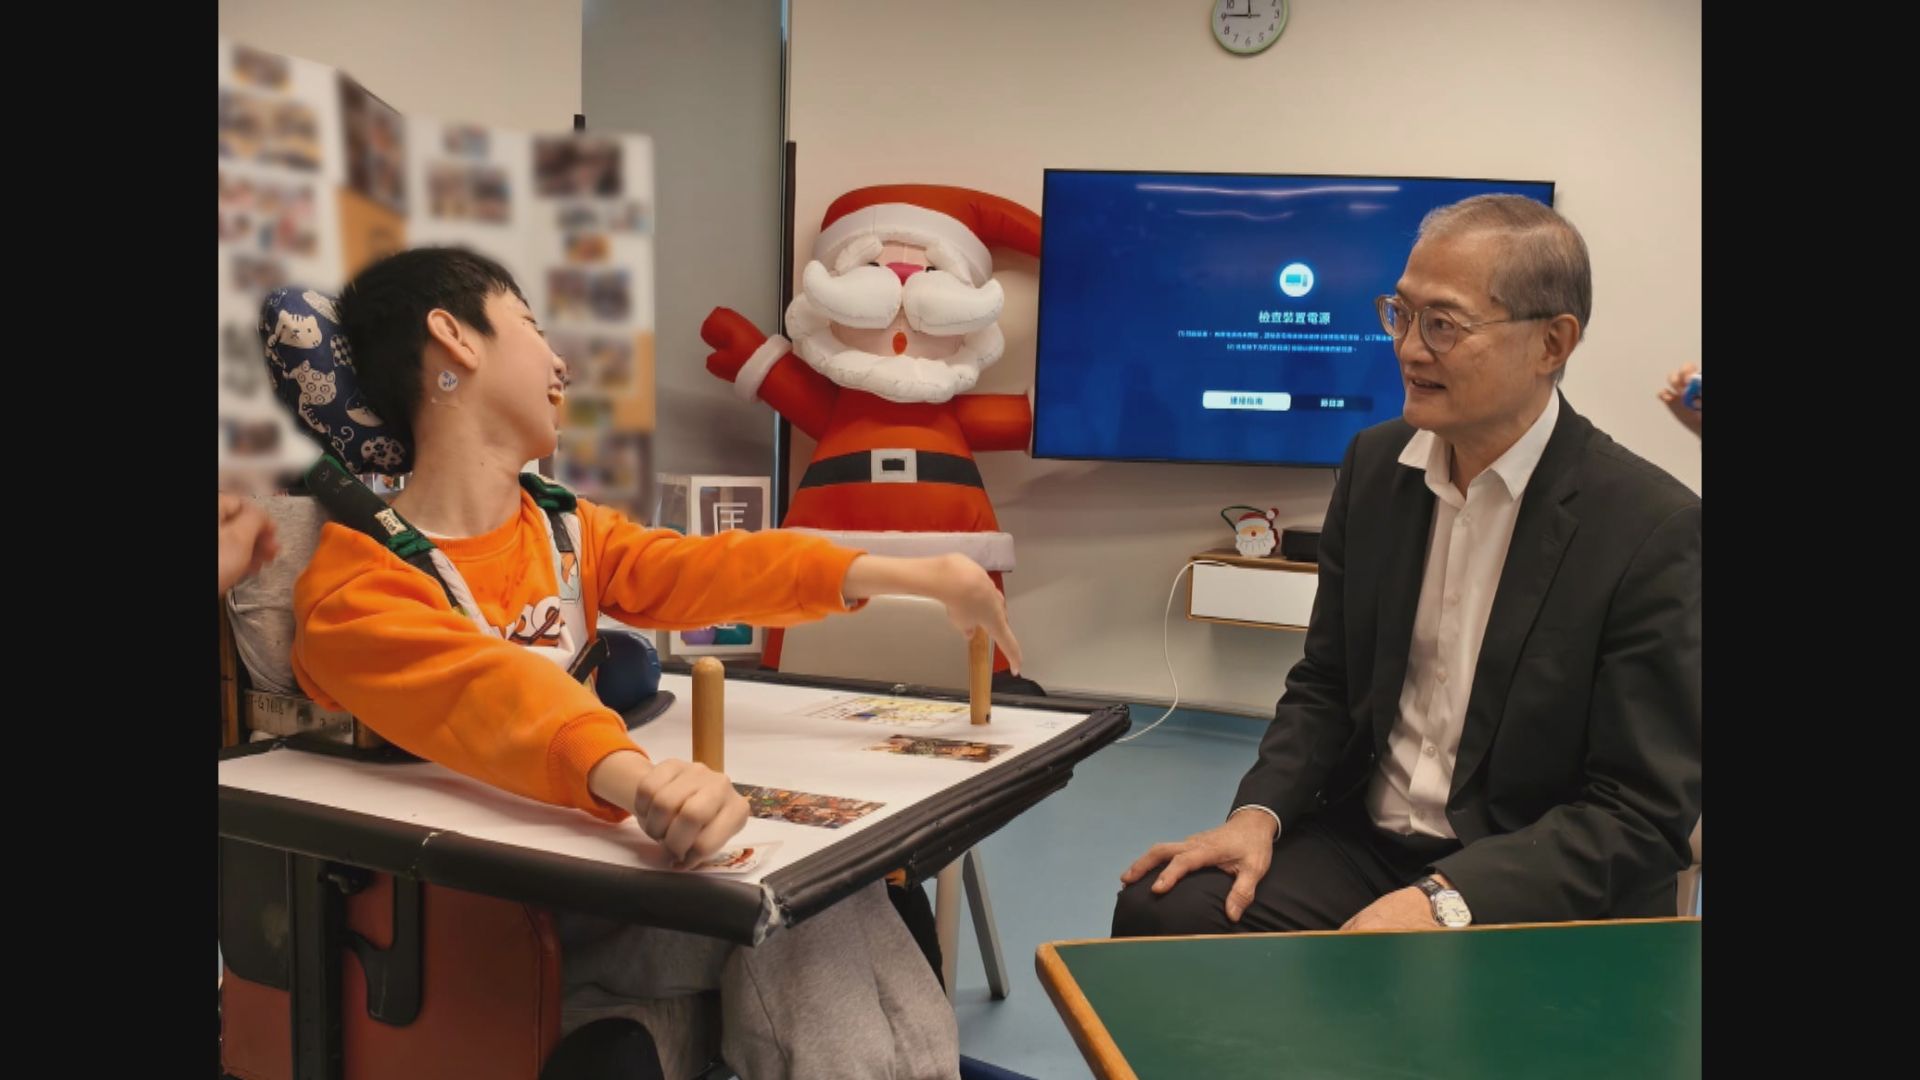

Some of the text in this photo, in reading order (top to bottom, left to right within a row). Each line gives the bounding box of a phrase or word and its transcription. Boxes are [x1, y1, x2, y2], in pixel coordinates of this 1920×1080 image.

[1274, 8, 1280, 19] 3
[1224, 25, 1230, 36] 8
[1268, 23, 1274, 32] 4
[1233, 33, 1239, 44] 7
[1244, 36, 1251, 47] 6
[1258, 32, 1264, 43] 5
[1258, 310, 1331, 325] 檢查裝置電源
